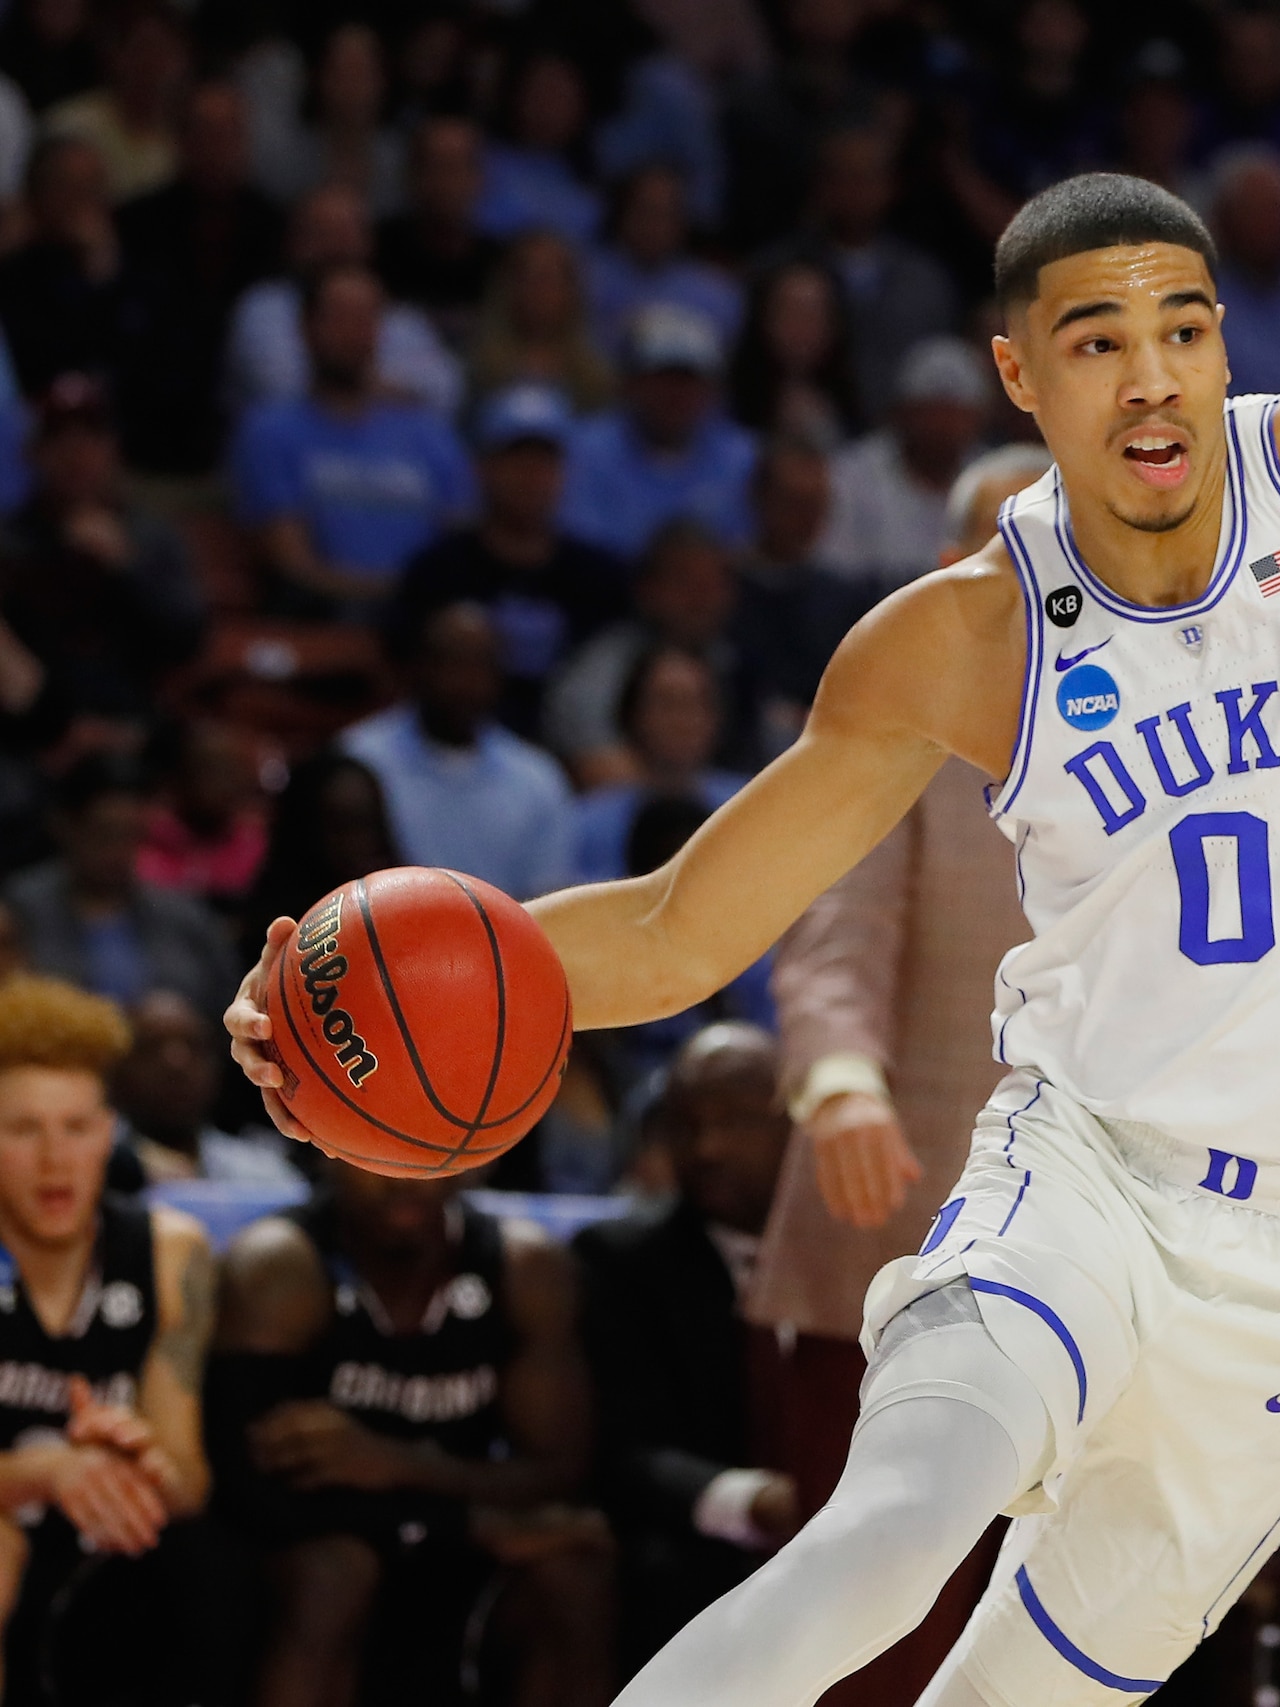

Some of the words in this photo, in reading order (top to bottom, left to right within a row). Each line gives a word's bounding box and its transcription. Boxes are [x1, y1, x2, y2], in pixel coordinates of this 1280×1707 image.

[1052, 595, 1077, 616] KB
[1066, 693, 1119, 716] NCAA
[1169, 811, 1276, 966] 0
[297, 893, 379, 1089] Wilson
[1198, 1148, 1258, 1200] D
